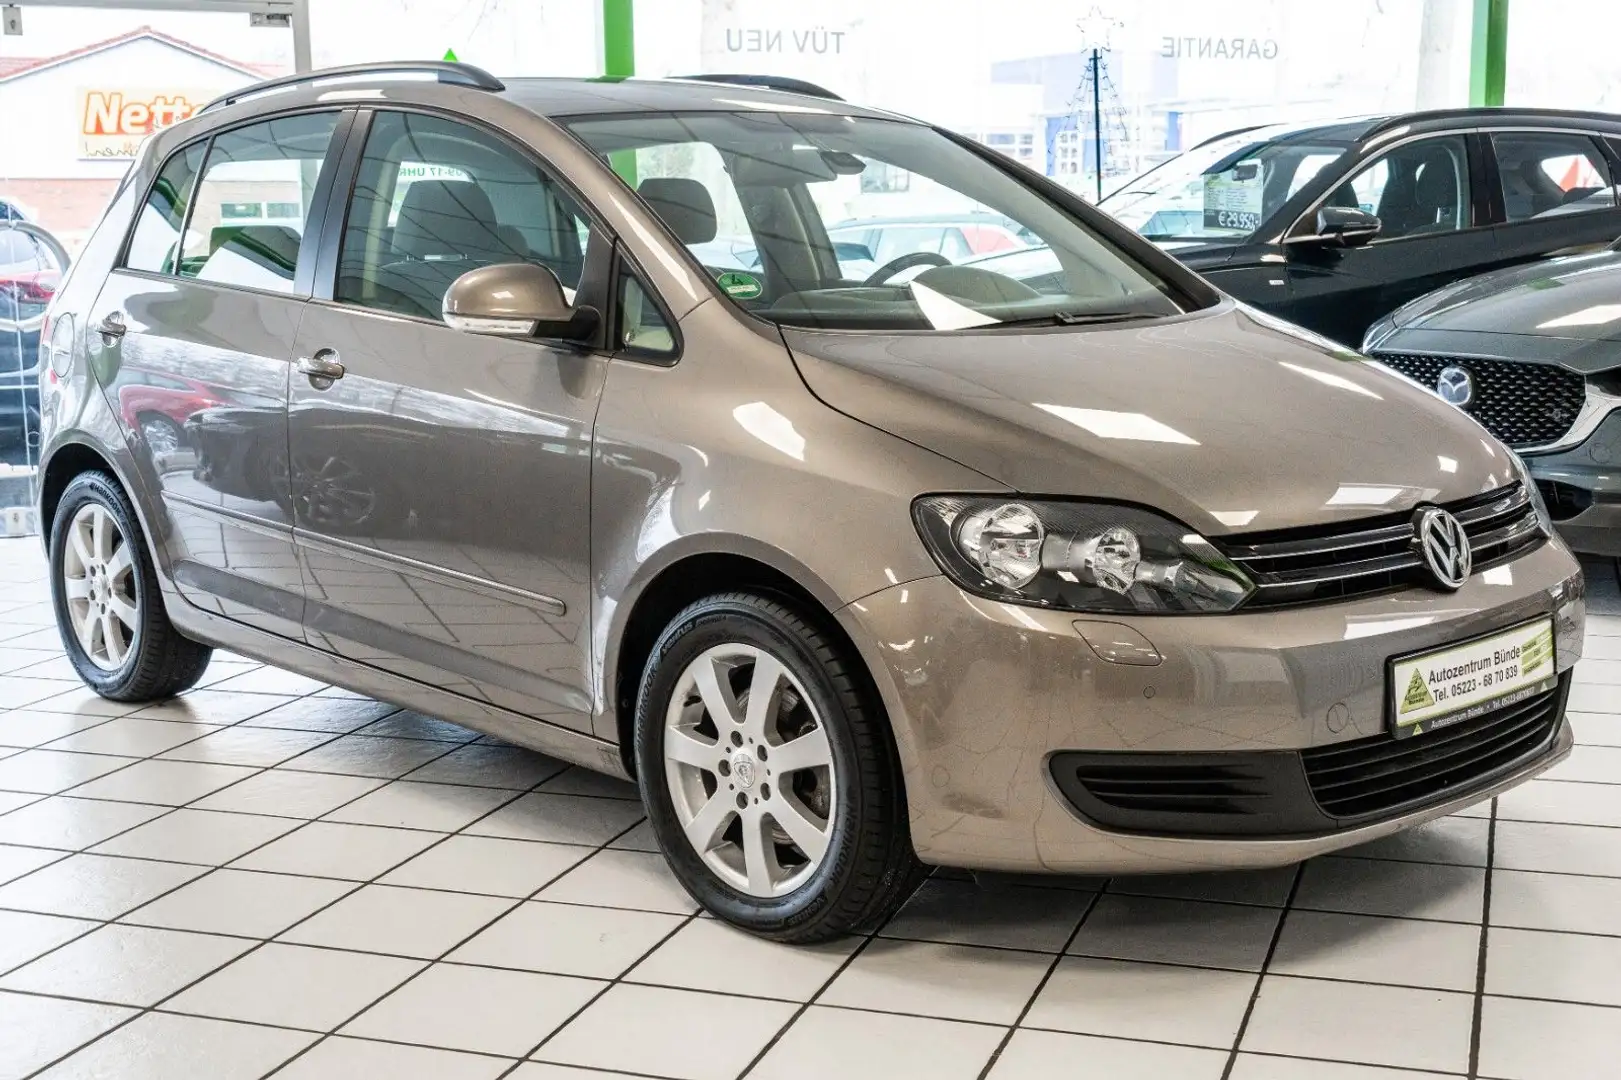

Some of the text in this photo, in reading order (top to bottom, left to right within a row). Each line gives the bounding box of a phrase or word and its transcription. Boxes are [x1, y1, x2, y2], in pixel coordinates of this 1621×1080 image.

[1428, 656, 1493, 685] Autozentrum
[1493, 645, 1521, 666] Bünde
[1433, 686, 1449, 702] Tel.
[1451, 678, 1477, 697] 05223
[1483, 673, 1493, 687] 68
[1495, 669, 1504, 684] 70
[1505, 664, 1518, 680] 839
